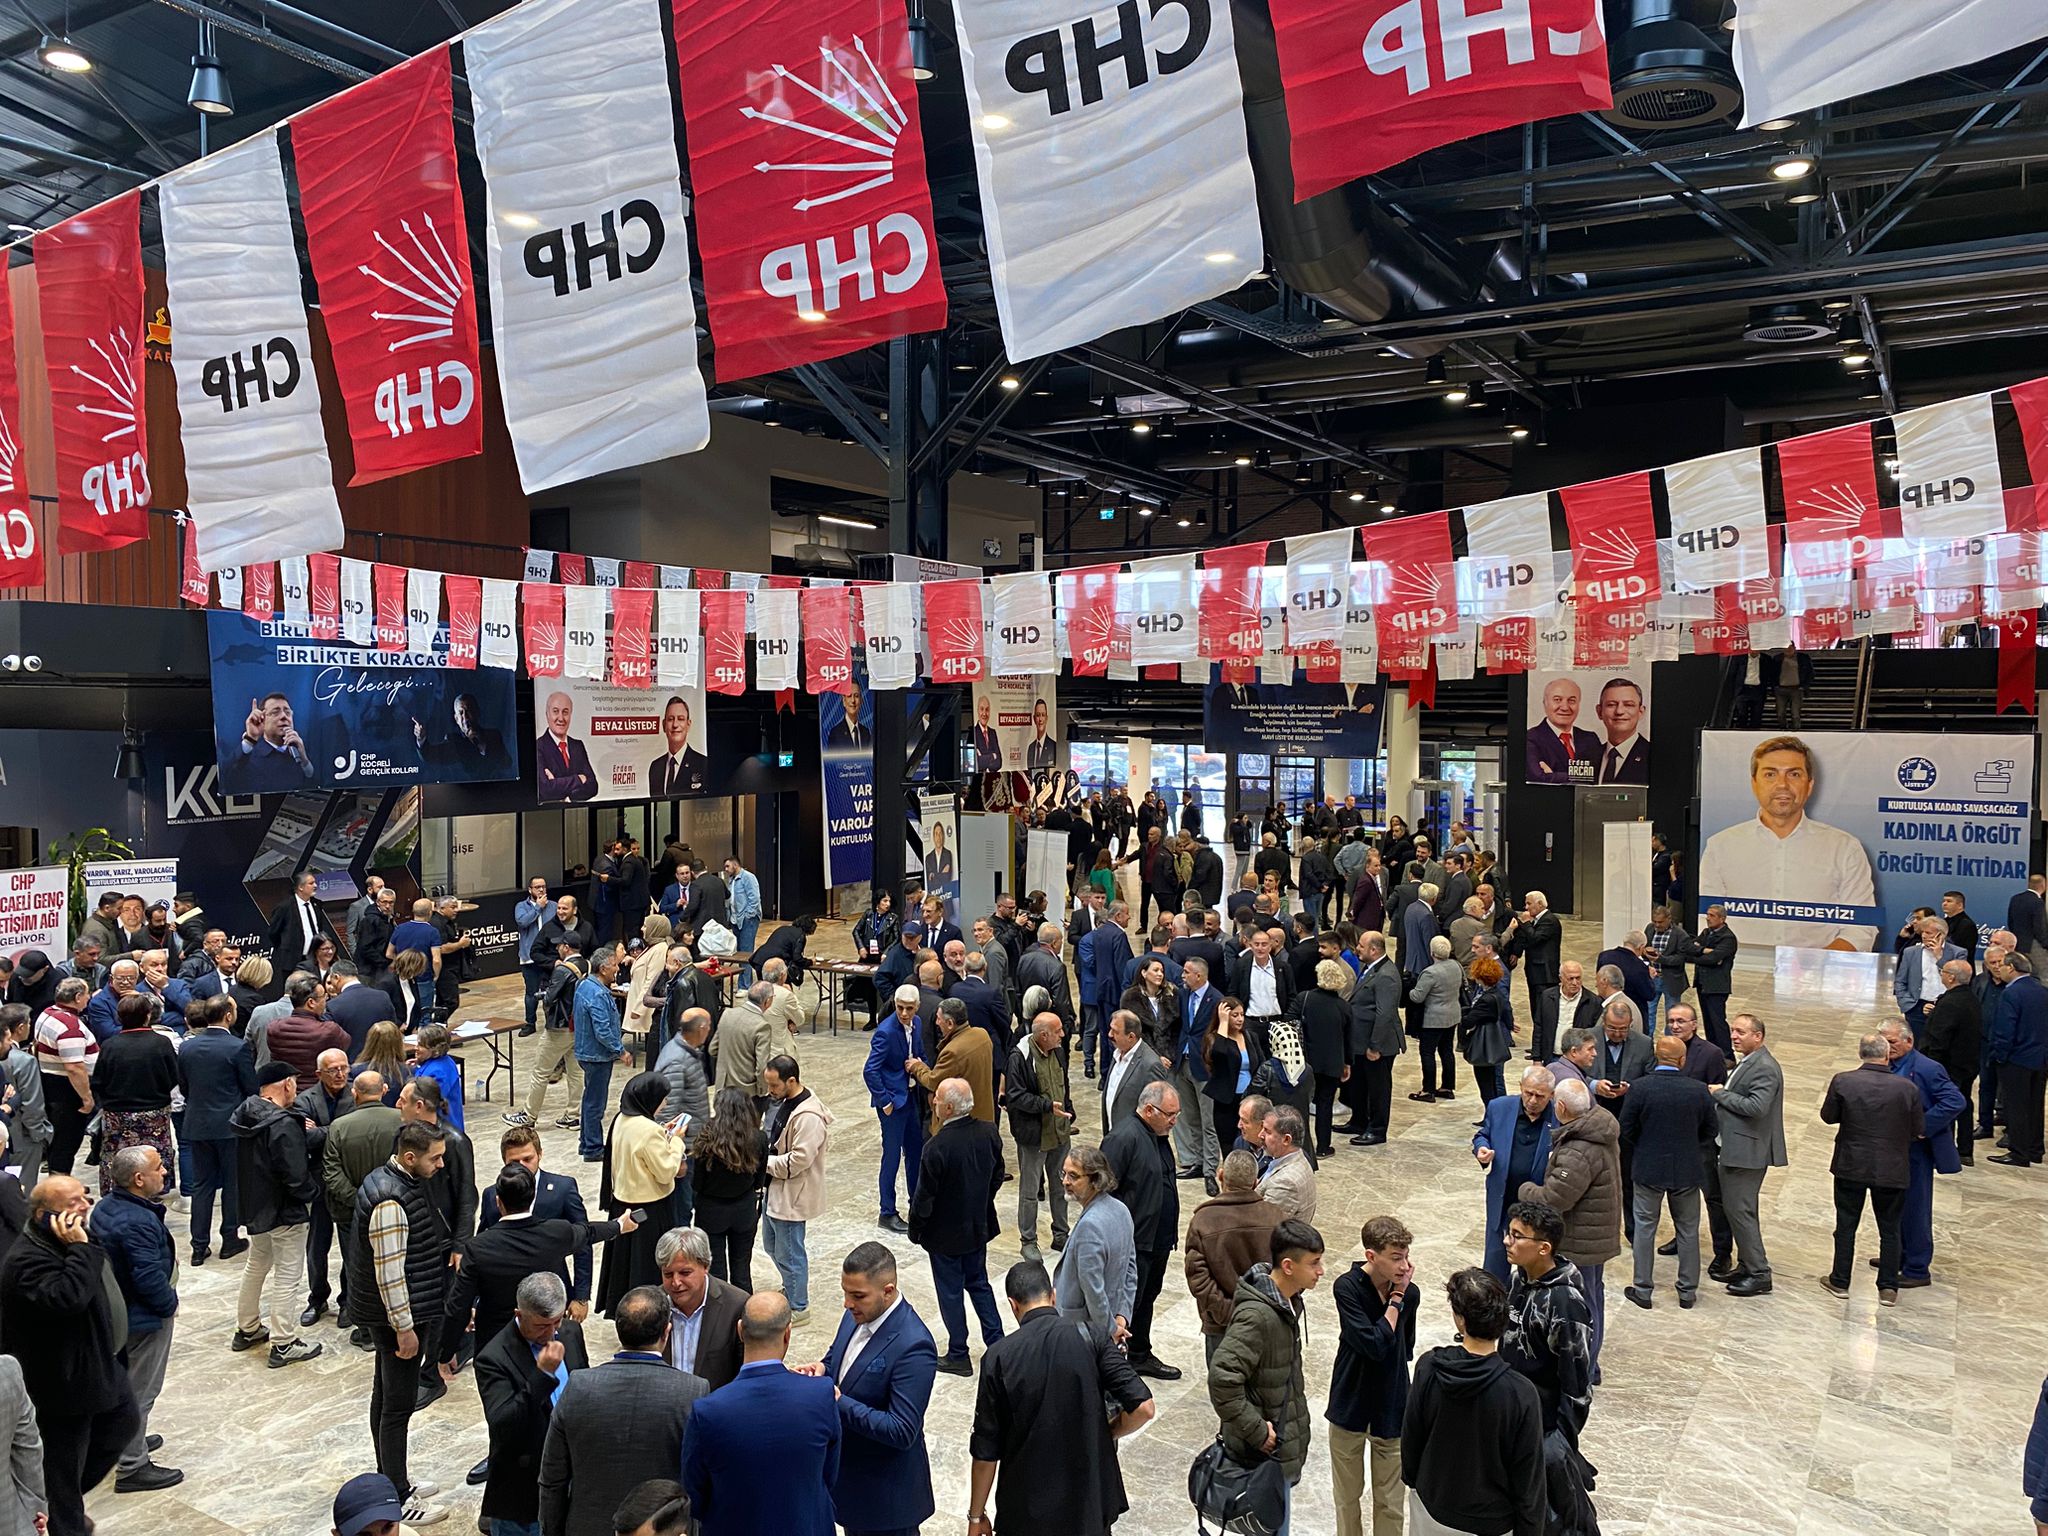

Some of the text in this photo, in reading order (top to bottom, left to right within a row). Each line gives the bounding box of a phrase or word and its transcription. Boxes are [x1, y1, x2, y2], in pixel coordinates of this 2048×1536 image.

[144, 348, 171, 361] KAF
[278, 646, 448, 667] BİRLİKTE KURACAĞ
[595, 718, 657, 731] BEYAZ LİSTEDE
[360, 766, 419, 776] GENÇLİK KOLLARI
[1568, 766, 1594, 776] ARCAN
[612, 773, 636, 785] ARCAN
[850, 784, 872, 797] VAR
[1888, 800, 2018, 815] KURTULUŞA KADAR SAVAŞACAĞIZ
[830, 815, 873, 832] VAROLA
[1884, 821, 2021, 845] KADINLA ÖRGÜT
[451, 843, 474, 855] GİŞE
[1877, 850, 2026, 879] ÖRGÜTLE İKTİDAR
[87, 866, 175, 878] VARDIK, VARIZ, VAROLACAĞIZ
[11, 873, 35, 891] CHP
[0, 891, 64, 914] CAELİ GENÇ
[1724, 901, 1855, 920] MAVİ LİSTEDEYİZ!
[0, 911, 59, 934] ETİŞİM AĞI
[464, 924, 503, 937] OCAELİ
[0, 933, 46, 947] GELİYOR
[228, 933, 260, 947] lerin
